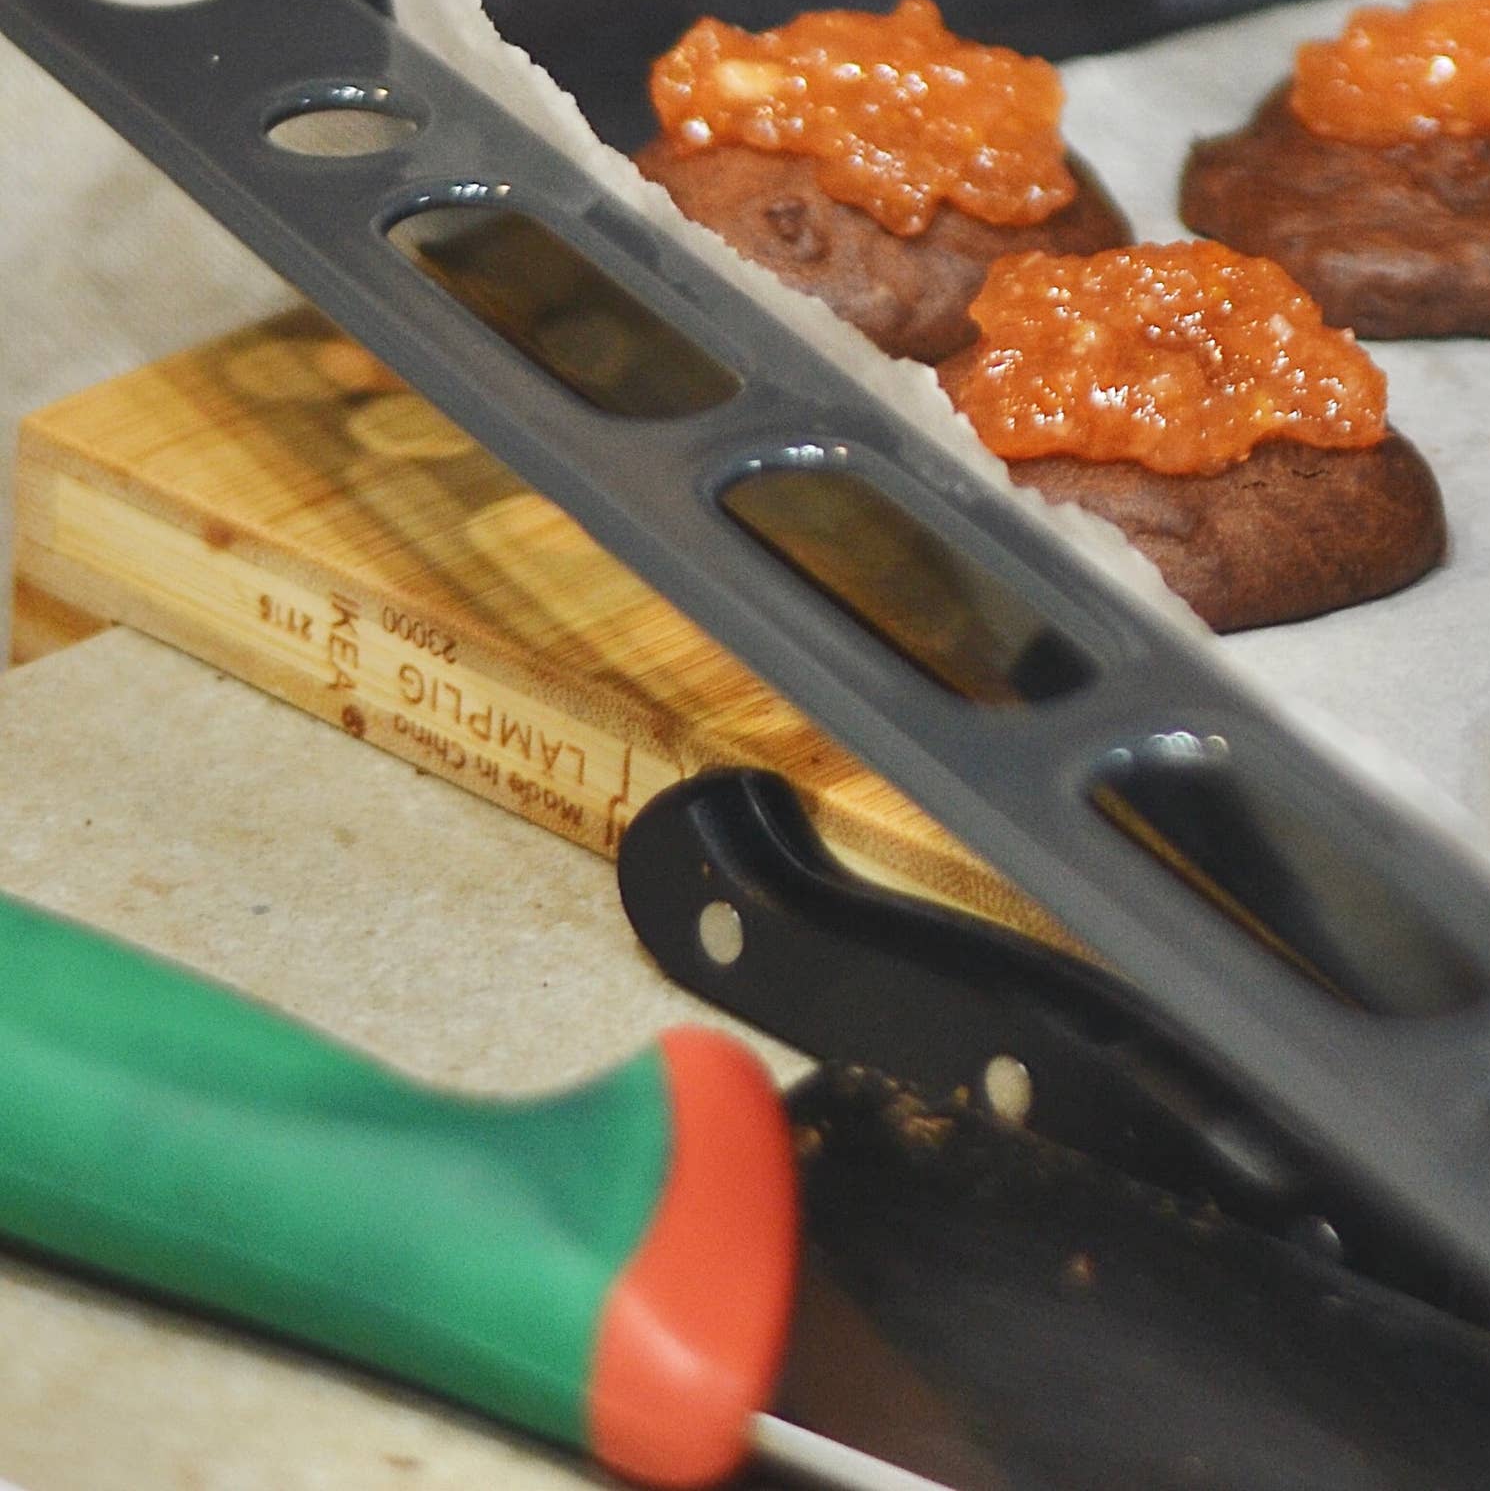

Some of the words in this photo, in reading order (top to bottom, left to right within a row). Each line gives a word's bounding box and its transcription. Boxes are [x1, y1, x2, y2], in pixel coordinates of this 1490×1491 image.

[328, 591, 363, 690] IKEA
[382, 605, 457, 664] 23000
[393, 713, 467, 771] China
[507, 771, 584, 827] Made
